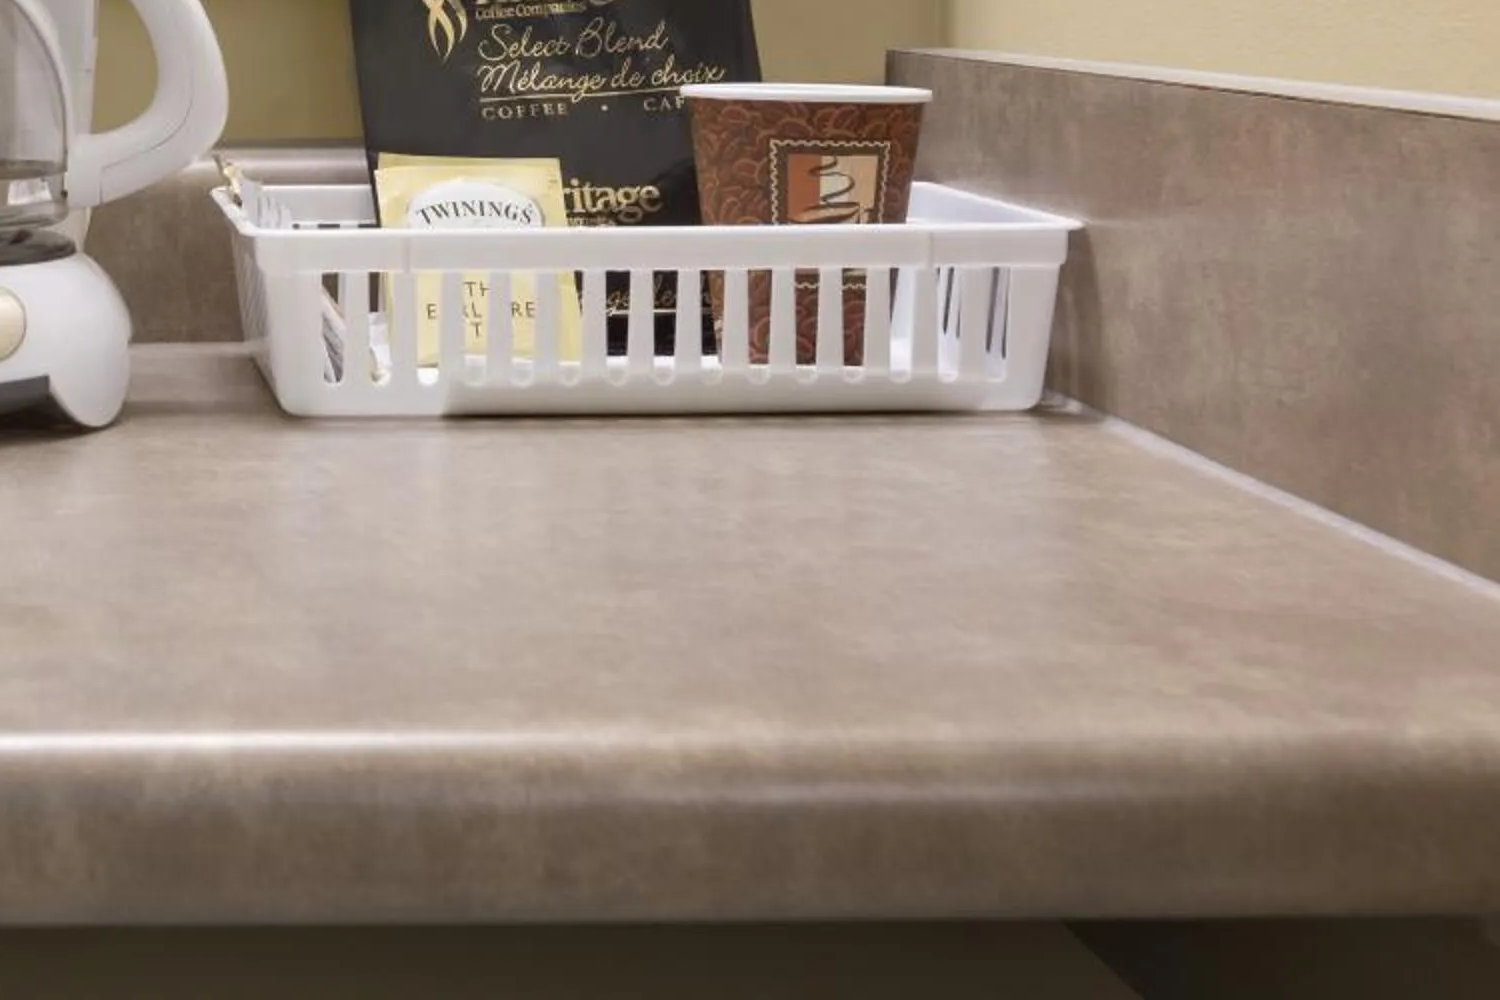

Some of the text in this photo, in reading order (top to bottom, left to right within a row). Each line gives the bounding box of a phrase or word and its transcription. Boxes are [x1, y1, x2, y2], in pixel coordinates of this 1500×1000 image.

[477, 16, 668, 61] Select Blend
[477, 53, 726, 104] Mélange de choix
[481, 94, 686, 120] COFFEE CAF
[415, 199, 532, 225] TWININGS
